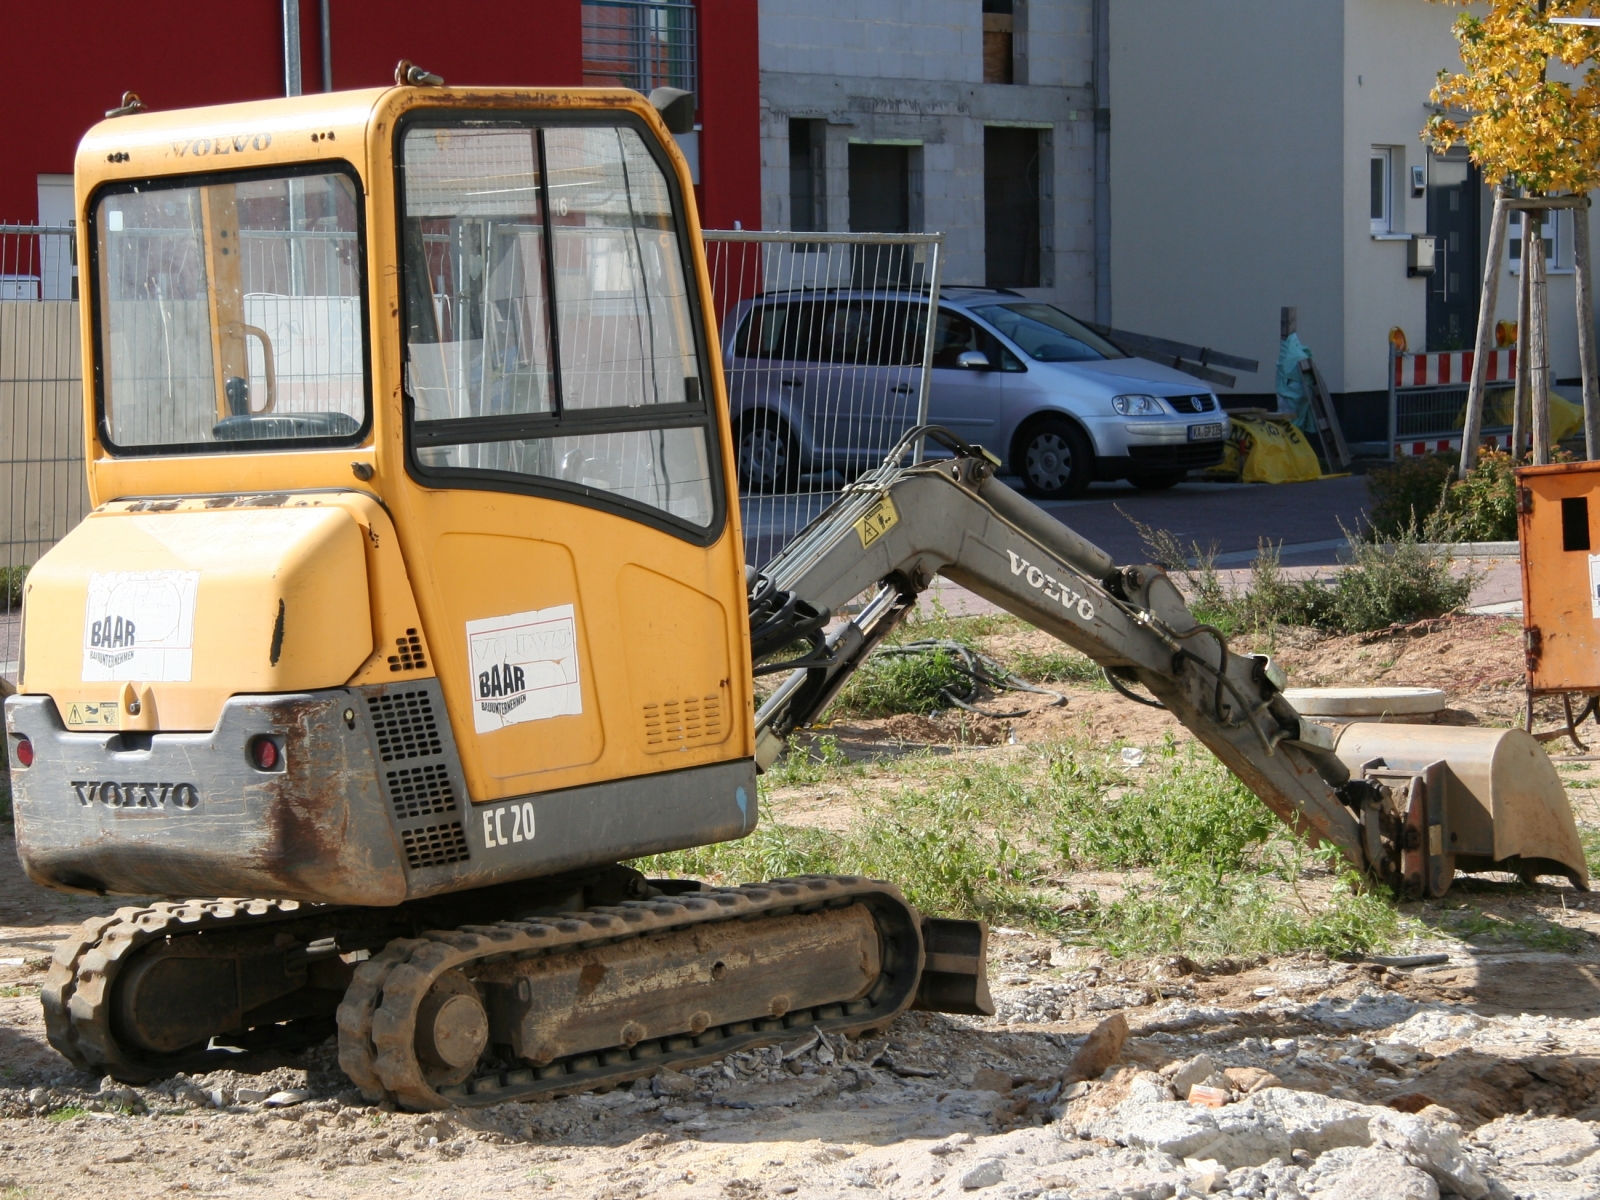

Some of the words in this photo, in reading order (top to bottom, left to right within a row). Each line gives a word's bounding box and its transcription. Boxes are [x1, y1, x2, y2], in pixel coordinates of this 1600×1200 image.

[169, 132, 272, 158] VOLVO
[553, 197, 568, 217] 16
[1006, 549, 1095, 621] VOLVO
[90, 614, 136, 649] BAAR
[478, 663, 526, 698] BAAR
[71, 781, 200, 811] VOLVO
[482, 807, 508, 849] EC
[510, 802, 536, 843] 20
